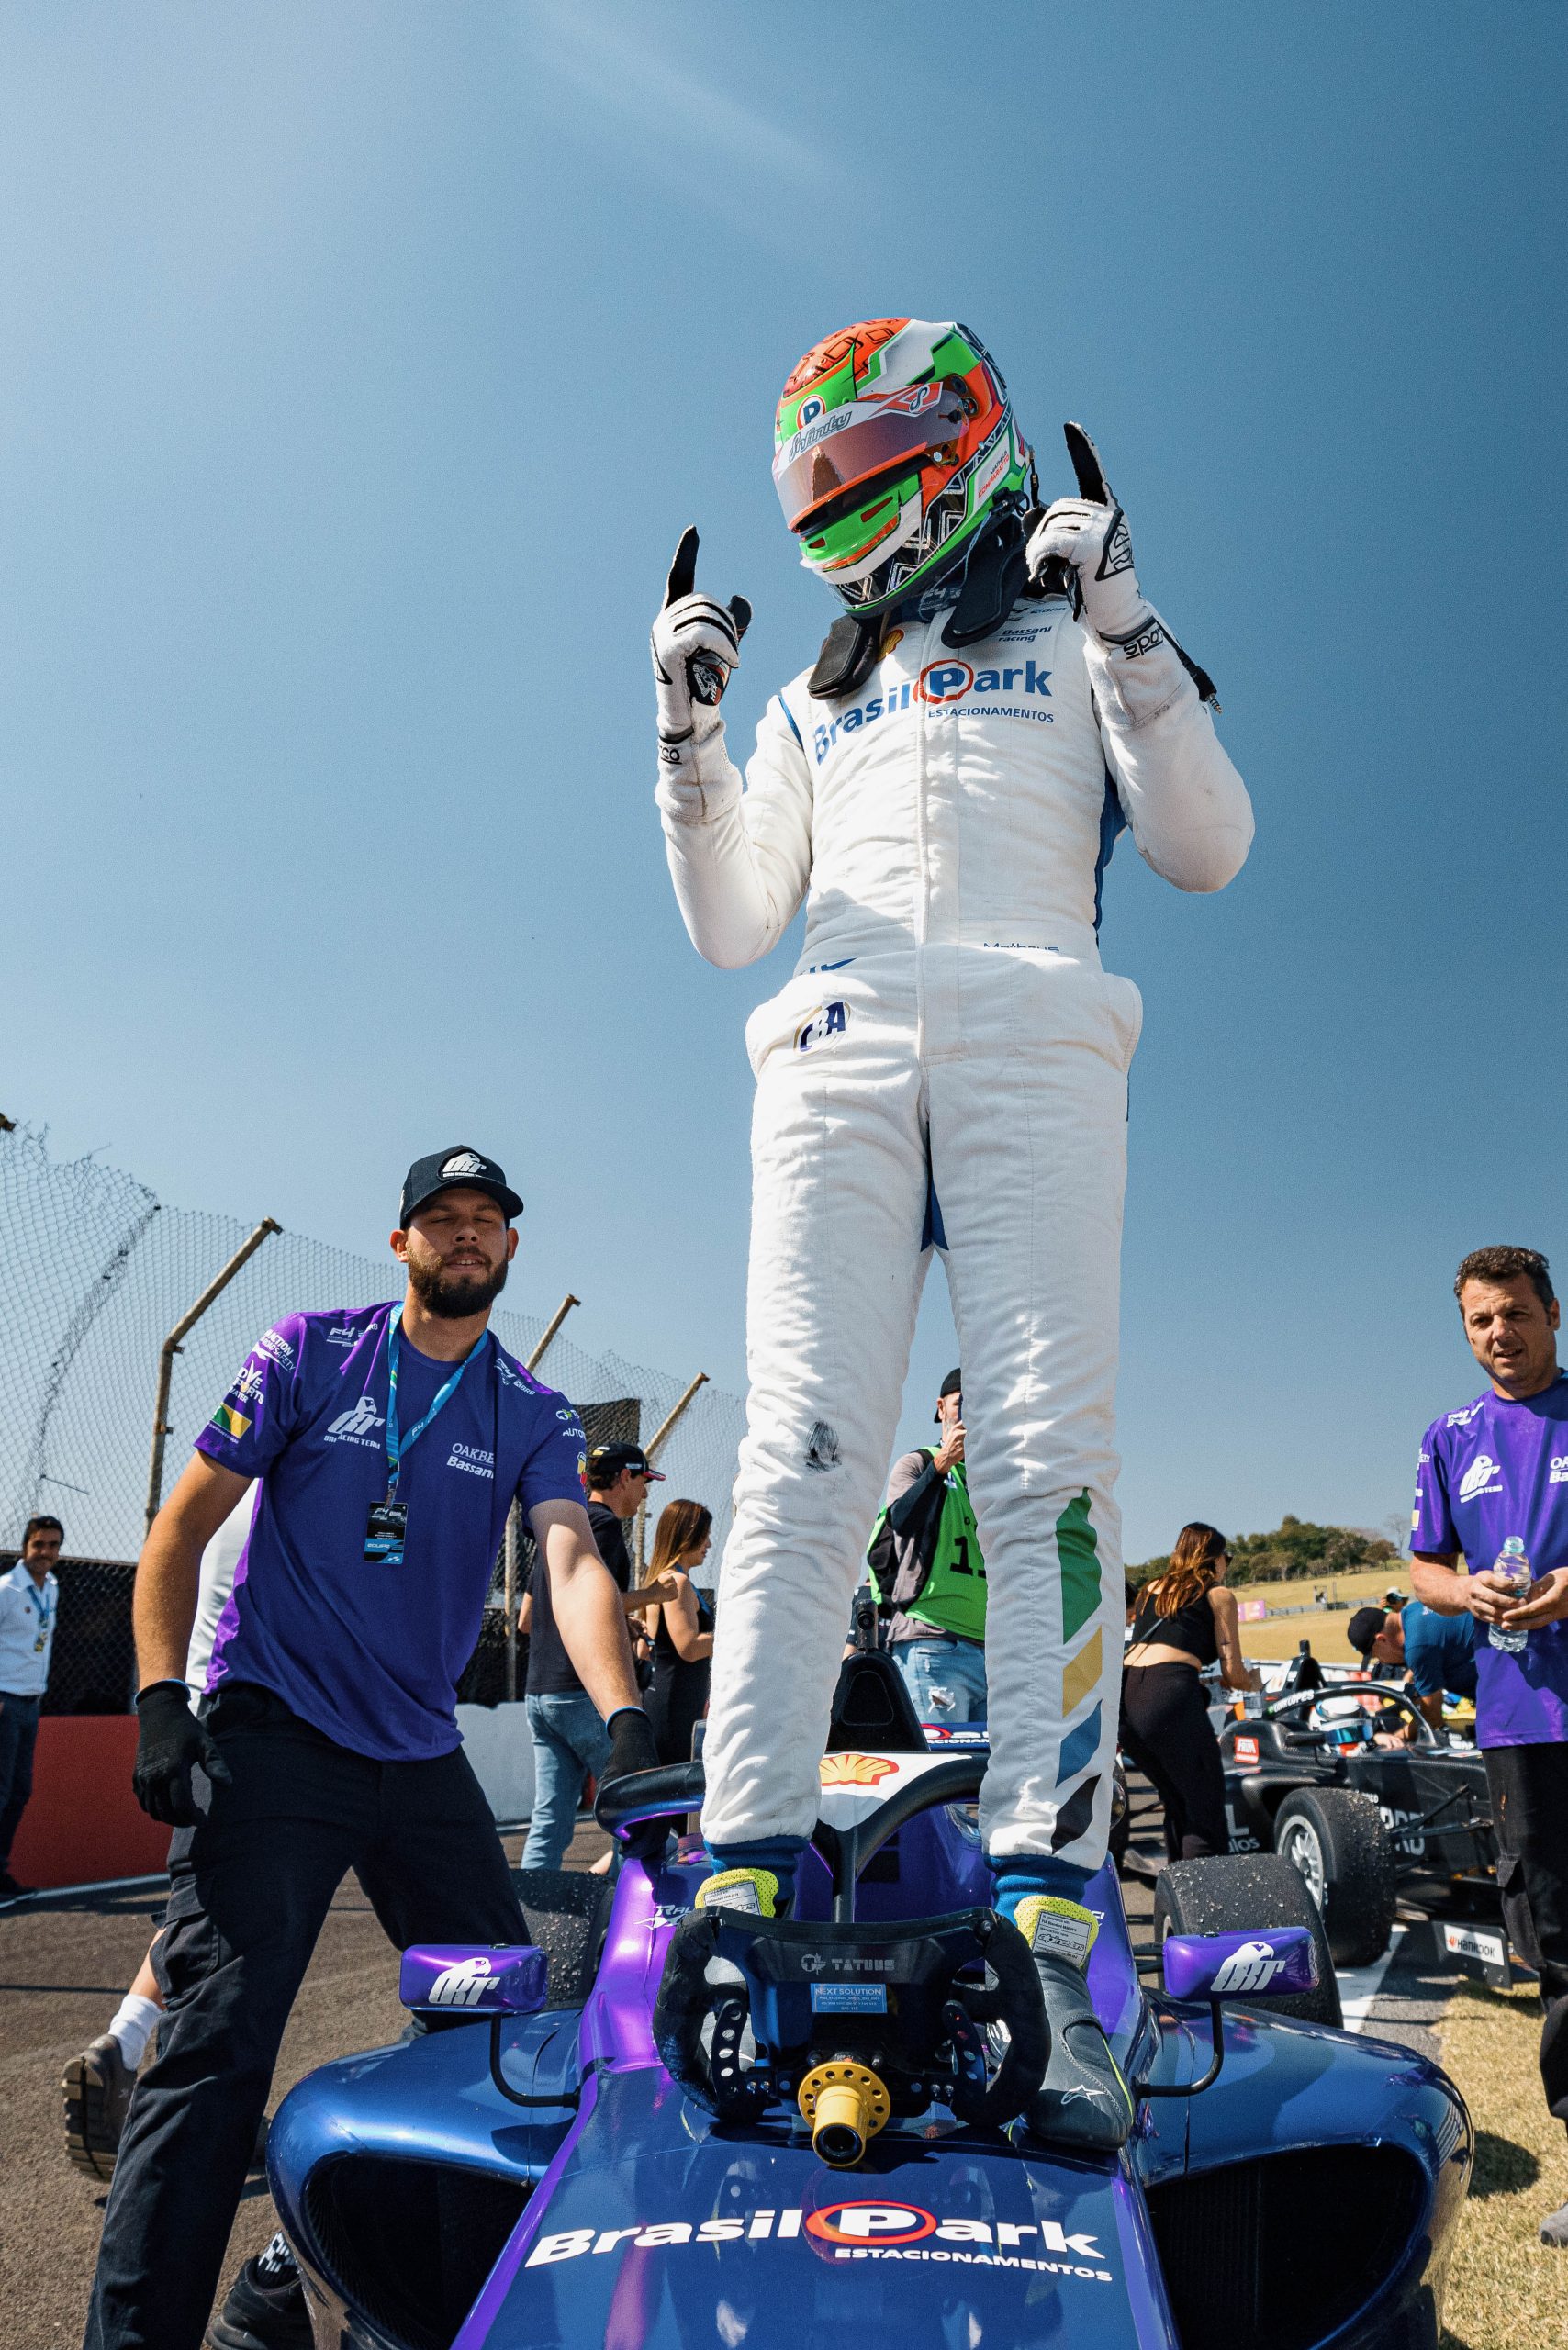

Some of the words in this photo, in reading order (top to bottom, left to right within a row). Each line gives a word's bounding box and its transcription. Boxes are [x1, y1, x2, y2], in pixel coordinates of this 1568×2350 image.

[789, 410, 852, 463] Infinity
[927, 707, 1055, 723] ESTACIONAMENTOS
[361, 1438, 381, 1449] TEAM
[831, 1958, 895, 1972] TATUUS
[815, 1987, 837, 1996] NEXT
[839, 1987, 882, 1996] SOLUTION
[524, 2208, 804, 2268] Brasil
[834, 2247, 1114, 2282] ESTACIONAMENTOS
